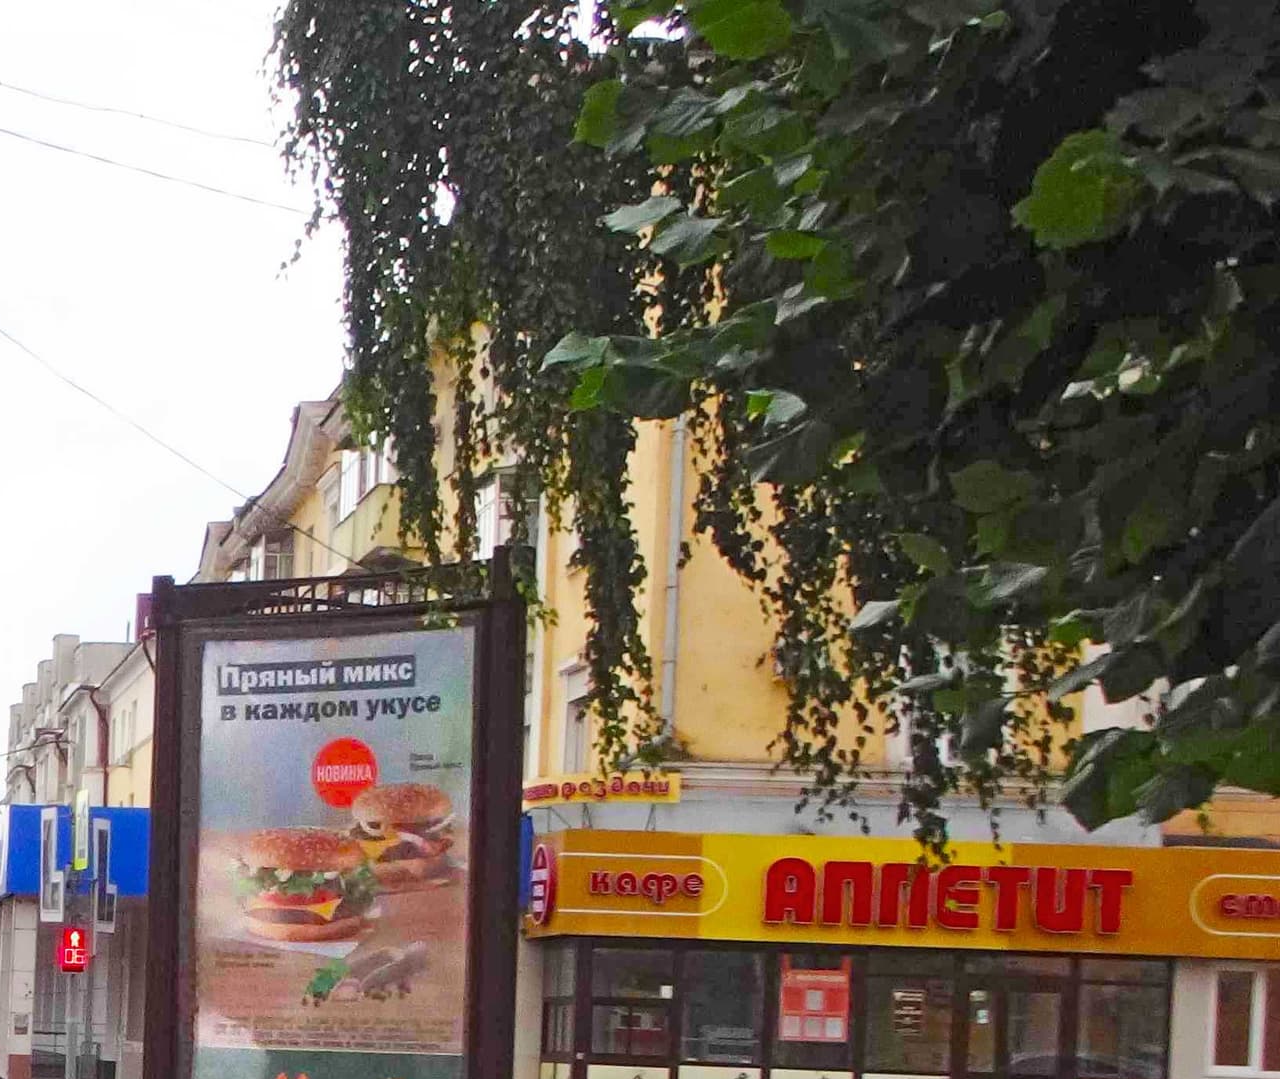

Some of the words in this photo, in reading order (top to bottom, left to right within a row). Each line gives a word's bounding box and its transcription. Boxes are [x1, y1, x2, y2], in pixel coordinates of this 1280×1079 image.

[220, 661, 336, 692] Пряный
[343, 661, 413, 683] микс
[221, 705, 237, 721] в
[244, 699, 358, 722] каждом
[366, 694, 441, 721] укусе
[316, 763, 373, 783] НОВИНКА
[590, 870, 705, 905] кафе
